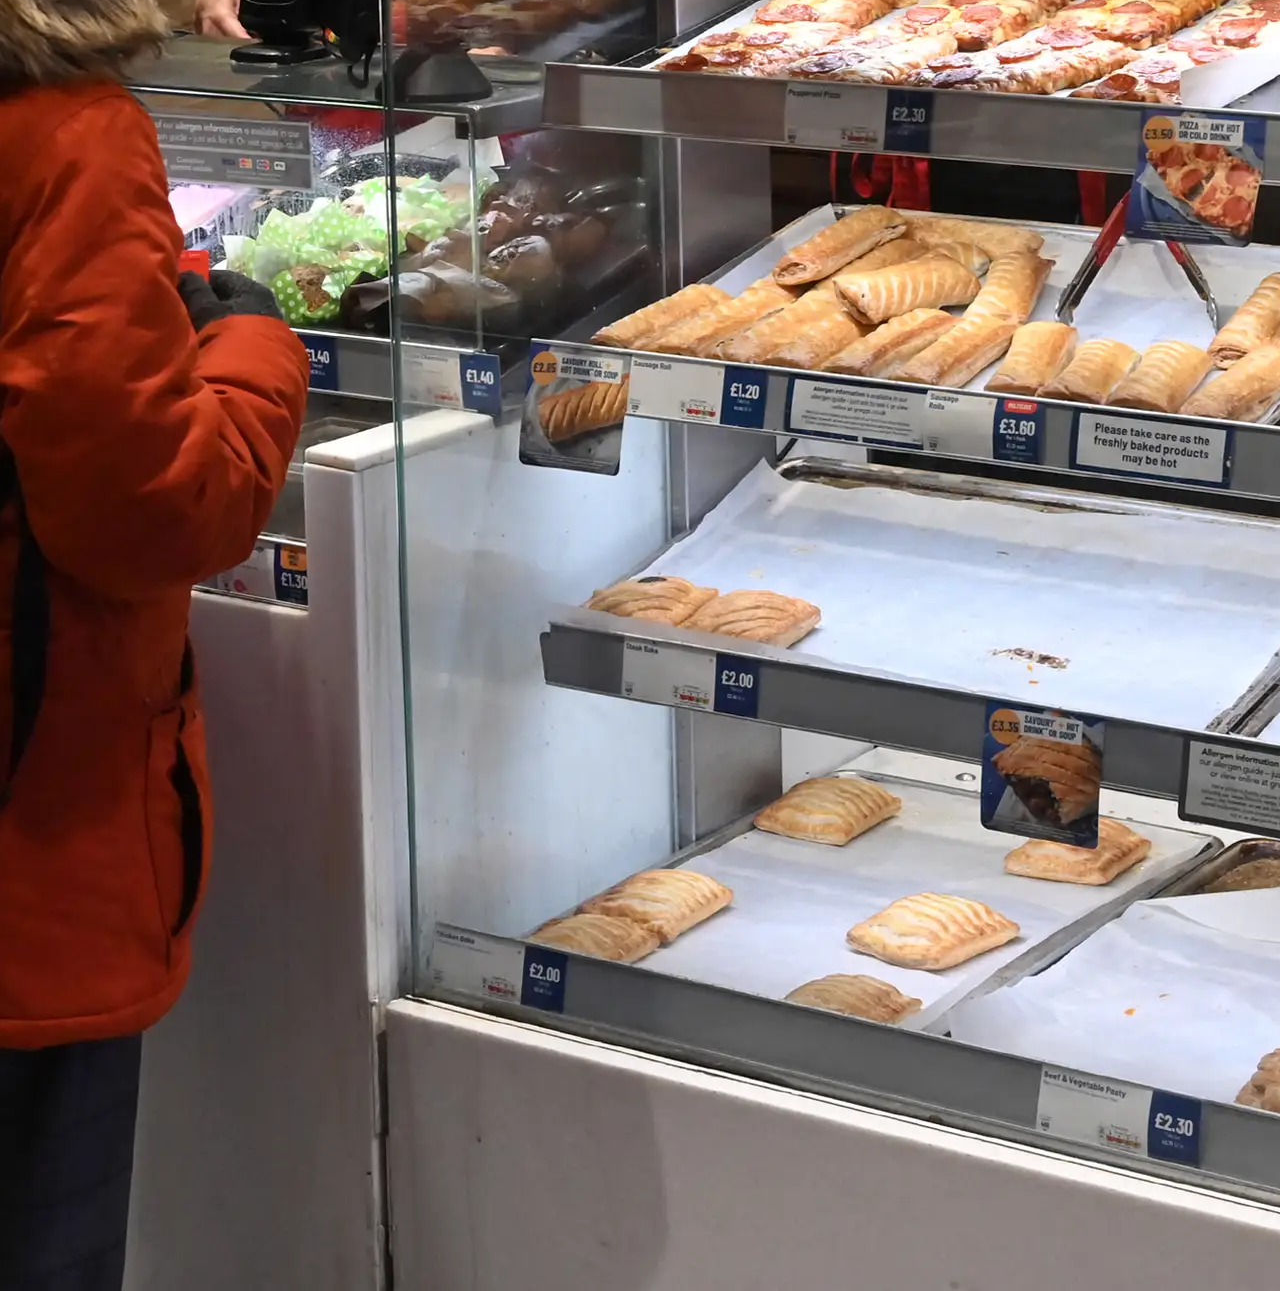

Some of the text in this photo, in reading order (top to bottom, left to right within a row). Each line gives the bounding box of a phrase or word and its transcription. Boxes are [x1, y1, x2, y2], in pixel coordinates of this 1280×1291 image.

[892, 106, 926, 122] £2.30
[1145, 129, 1173, 140] £3.50
[1179, 120, 1240, 133] PIZZA ANY HOT
[1179, 131, 1188, 139] OR
[1189, 132, 1208, 140] COLD
[306, 348, 330, 364] £1.40
[633, 360, 658, 370] Sausage
[466, 369, 494, 385] £1.40
[730, 383, 760, 400] £1.20
[930, 393, 959, 403] Sausage
[929, 402, 945, 410] Rolls
[999, 419, 1035, 436] £3.60
[1095, 423, 1210, 446] Please take care as the
[1094, 435, 1209, 459] freshly baked products
[1122, 454, 1177, 468] may be hot
[281, 572, 307, 589] £1.30
[721, 670, 753, 688] £2.00
[991, 720, 1019, 733] £3.35
[1202, 748, 1234, 760] Allergen
[1235, 754, 1280, 767] information
[529, 963, 560, 983] £2.00
[1044, 1070, 1127, 1099] Beef & Vegetable Pasty
[1155, 1112, 1193, 1137] £2.30
